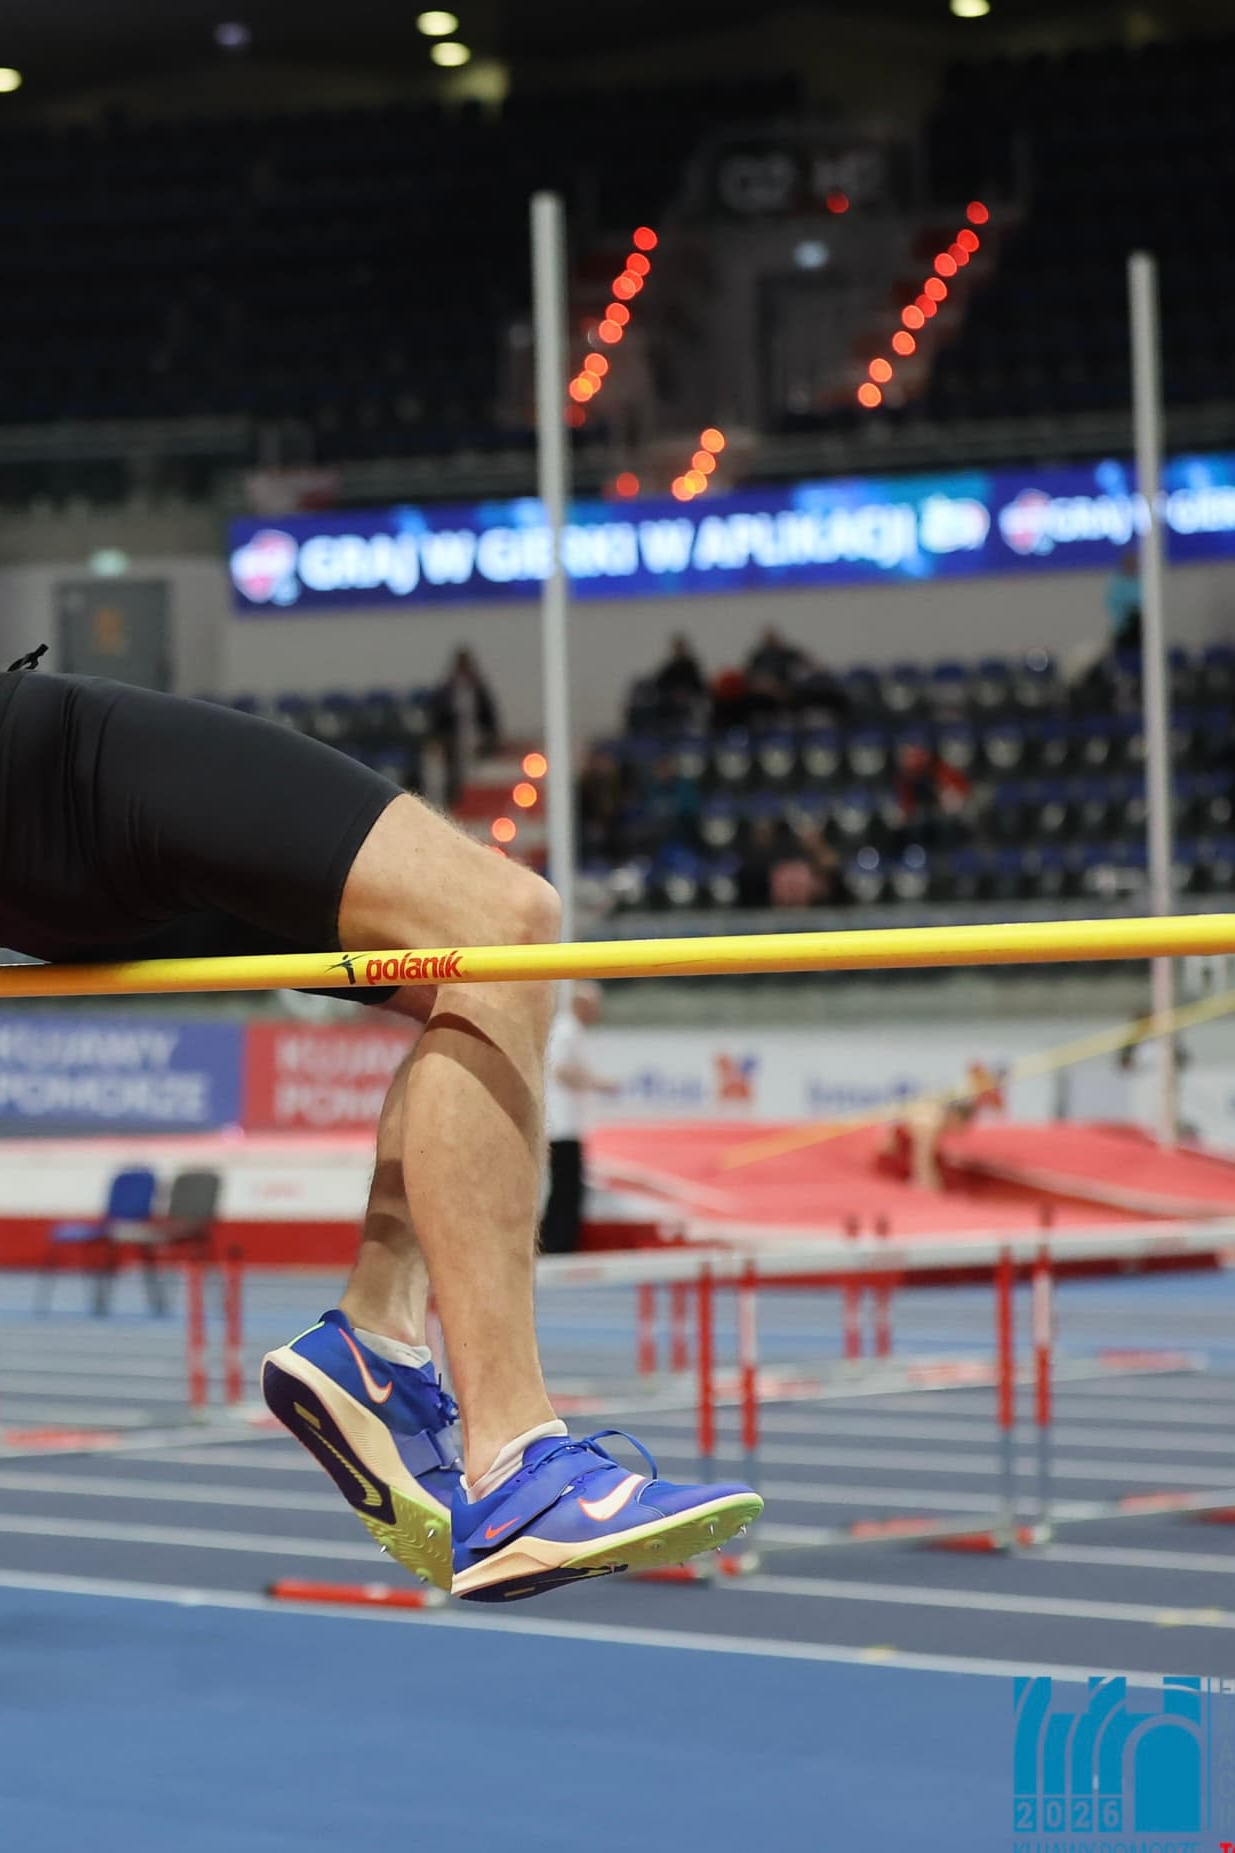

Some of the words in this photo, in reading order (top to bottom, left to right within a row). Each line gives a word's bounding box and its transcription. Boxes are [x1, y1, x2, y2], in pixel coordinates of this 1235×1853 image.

[420, 530, 477, 584] W
[638, 518, 695, 573] W
[365, 950, 463, 985] polanik
